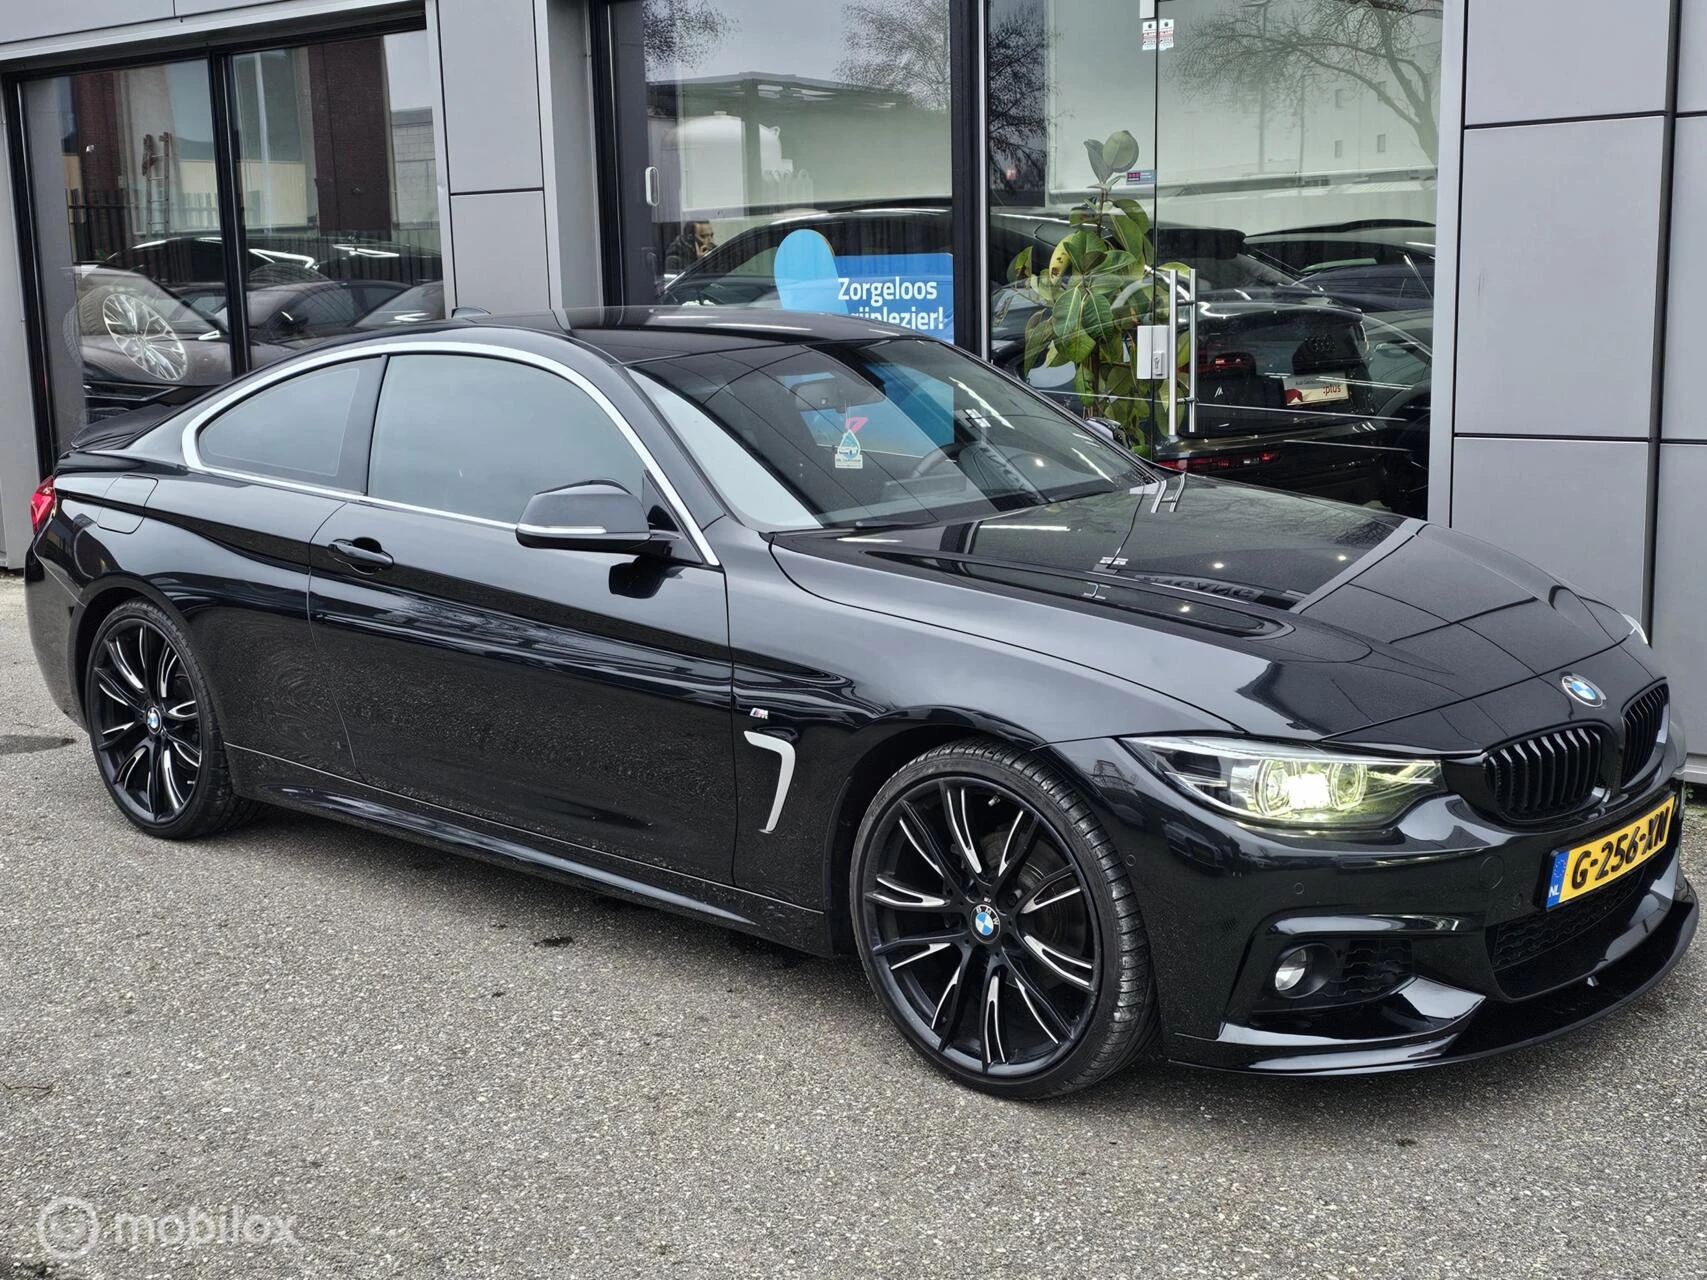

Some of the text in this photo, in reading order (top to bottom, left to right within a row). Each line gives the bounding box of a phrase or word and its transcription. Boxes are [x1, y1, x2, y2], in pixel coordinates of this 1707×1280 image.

[838, 276, 938, 307] Zorgeloos
[1571, 806, 1671, 890] G-256-XN
[1548, 884, 1560, 898] NL
